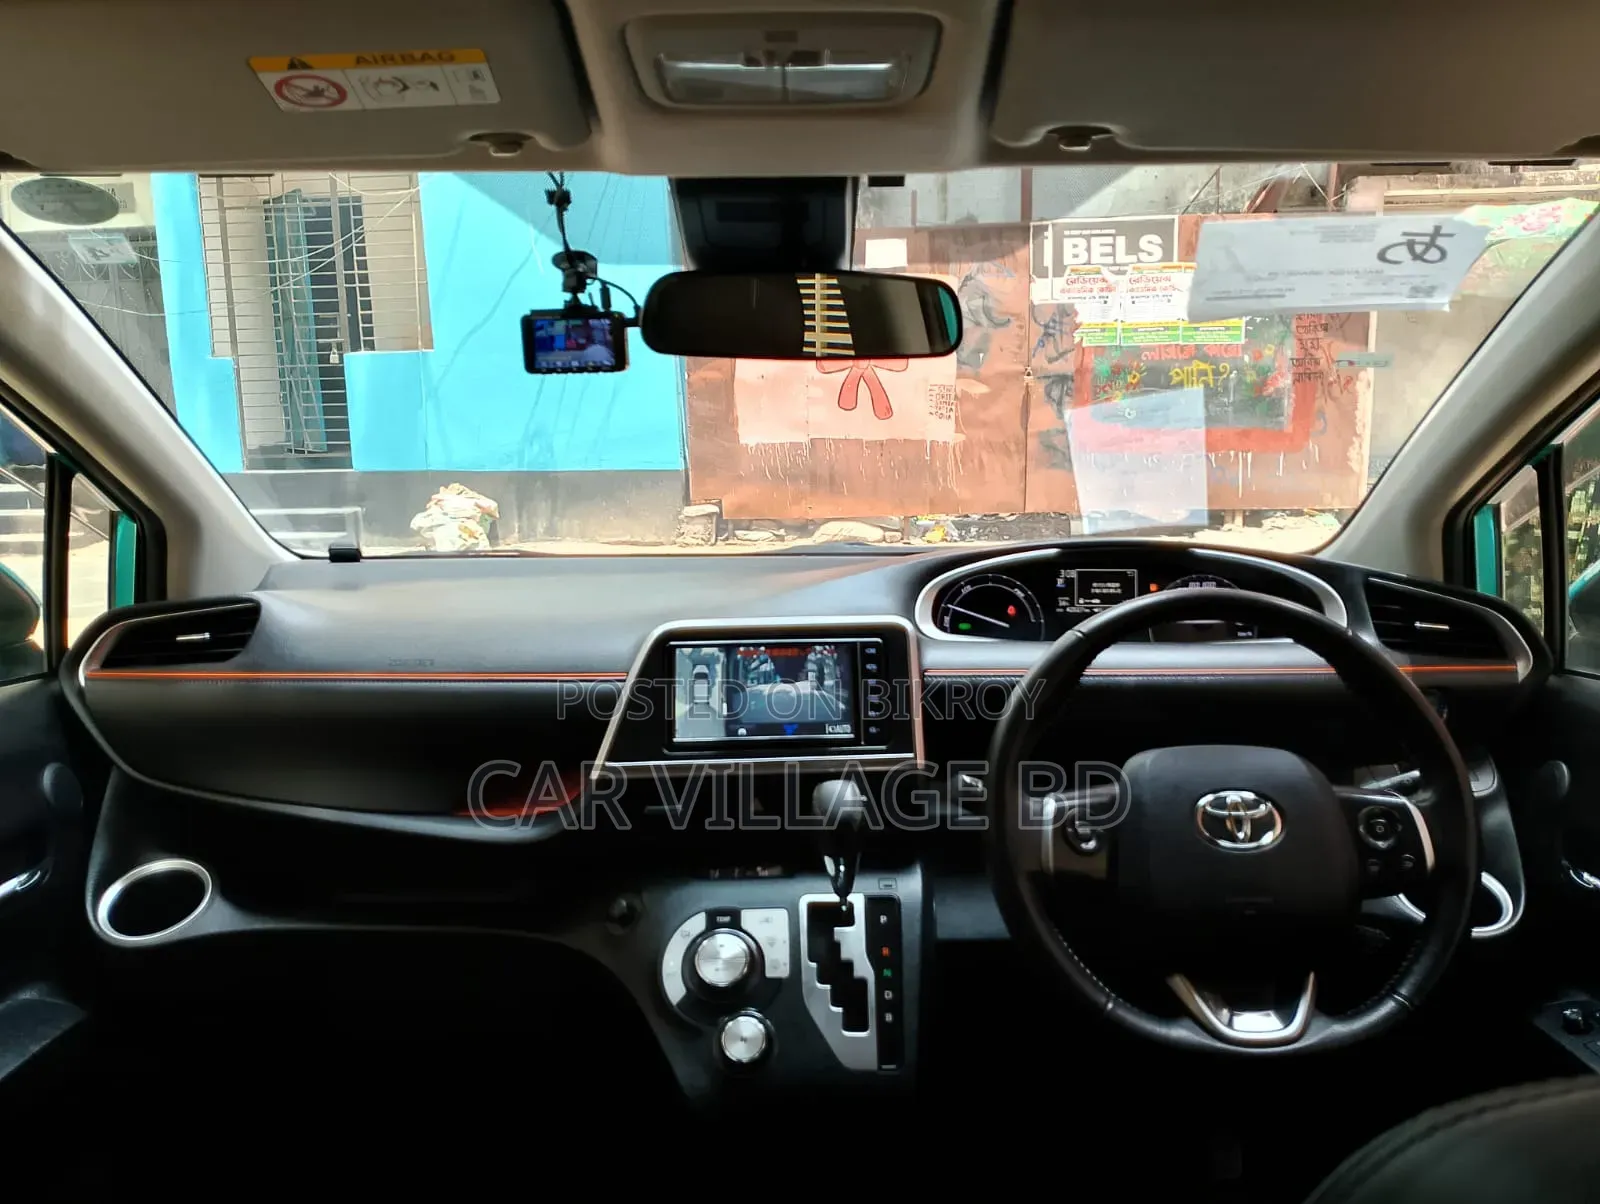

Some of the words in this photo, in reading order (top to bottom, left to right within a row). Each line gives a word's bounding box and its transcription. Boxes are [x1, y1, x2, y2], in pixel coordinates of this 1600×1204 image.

[355, 51, 455, 65] AIRBAG
[1063, 233, 1163, 265] BELS
[880, 914, 888, 925] P
[884, 990, 893, 1000] D
